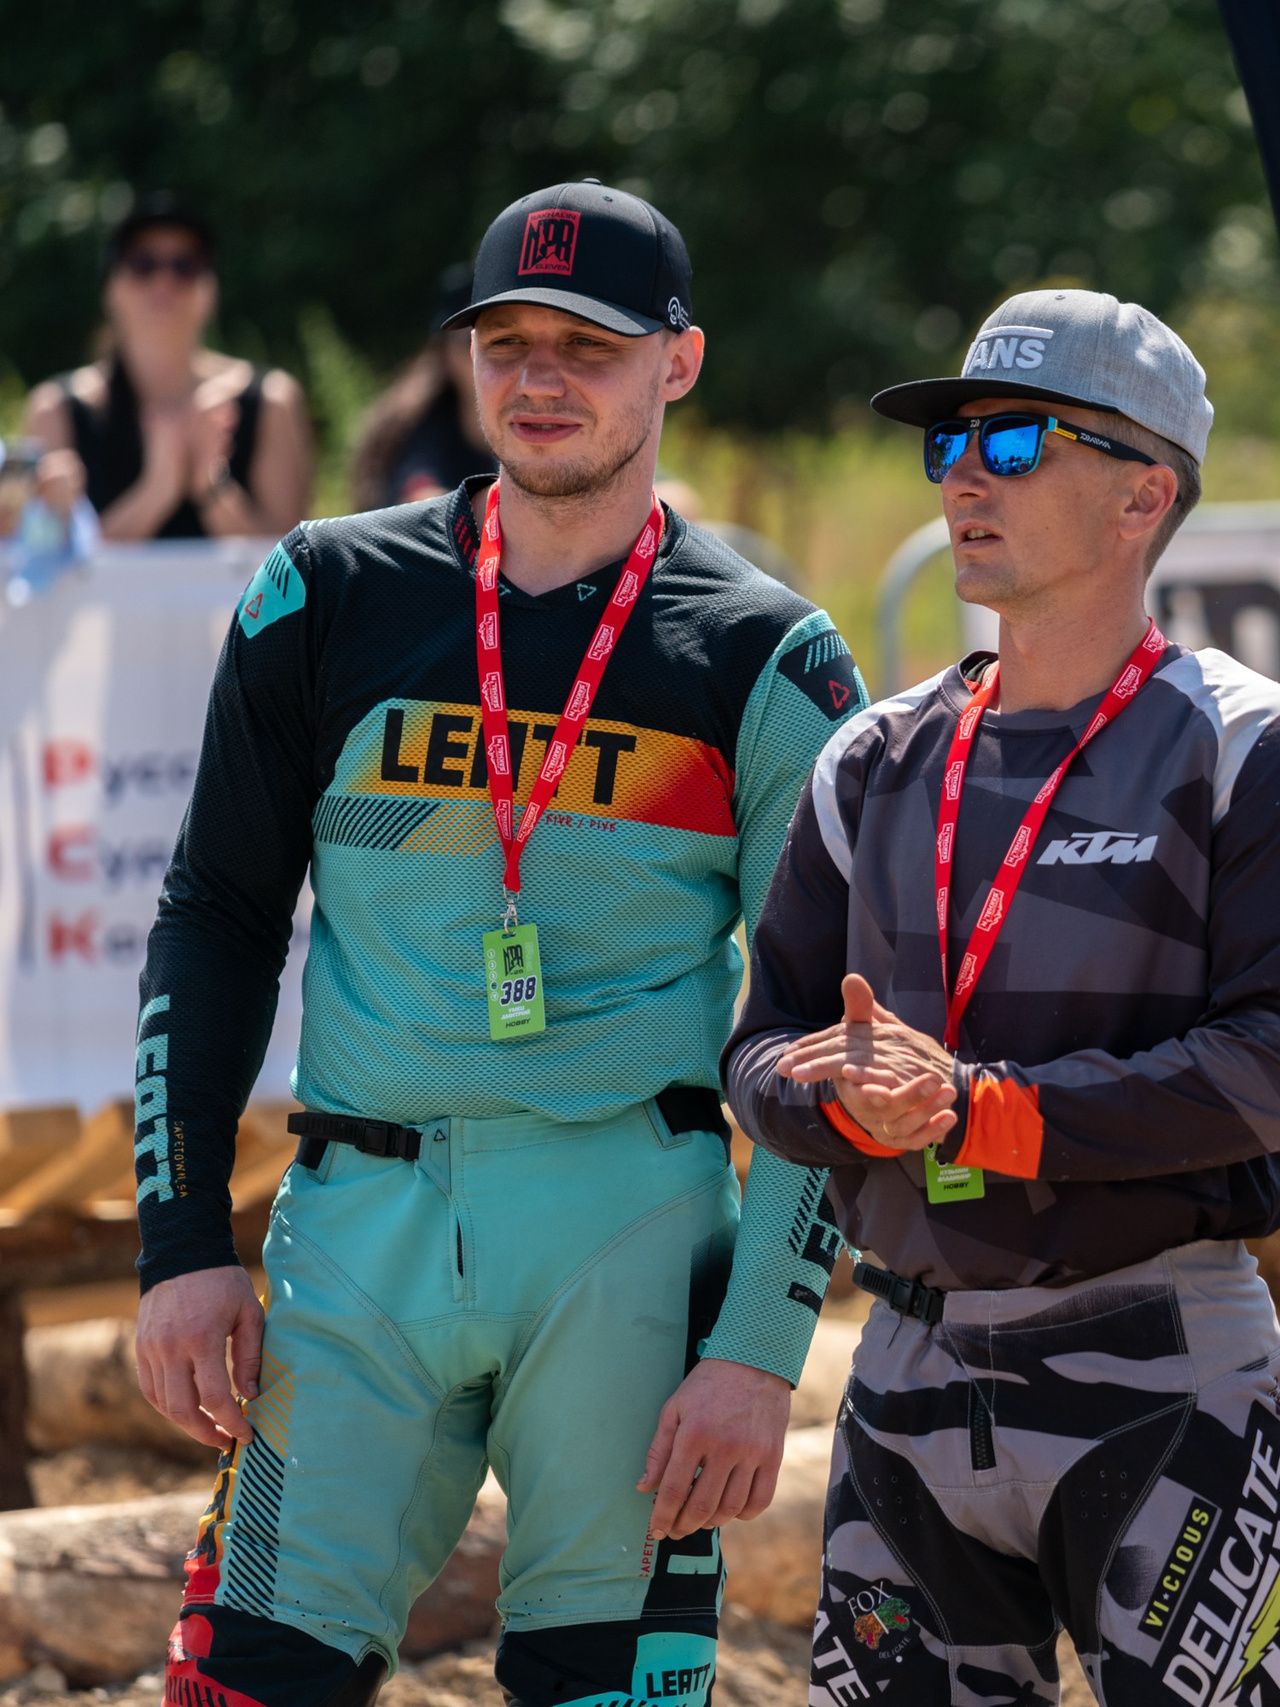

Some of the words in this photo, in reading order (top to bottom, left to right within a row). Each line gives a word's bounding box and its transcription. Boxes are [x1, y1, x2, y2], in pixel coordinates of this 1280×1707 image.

[1036, 831, 1158, 865] KTM
[500, 975, 537, 1007] 388
[848, 1580, 893, 1619] FOX
[878, 1635, 911, 1660] DELICATE
[646, 1663, 712, 1699] LEATT
